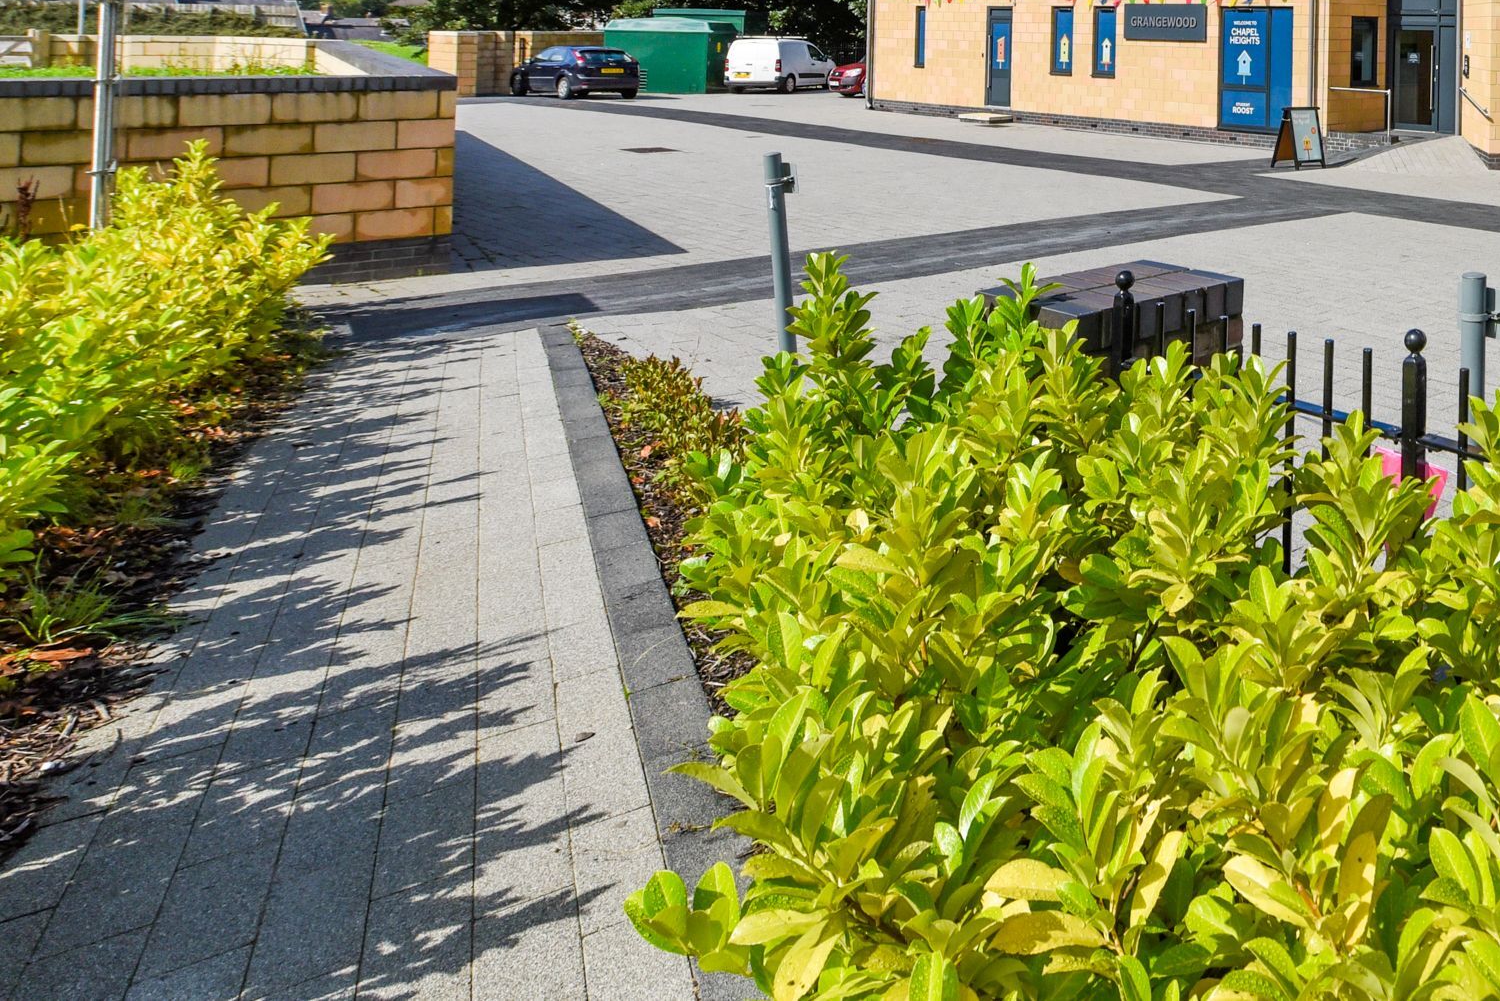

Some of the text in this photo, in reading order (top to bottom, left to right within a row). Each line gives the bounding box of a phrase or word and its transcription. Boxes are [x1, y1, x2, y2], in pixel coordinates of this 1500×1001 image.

[1131, 16, 1197, 28] GRANGEWOOD
[1231, 28, 1259, 36] CHAPEL
[1229, 37, 1260, 45] HEIGHTS
[1232, 106, 1254, 114] ROOST
